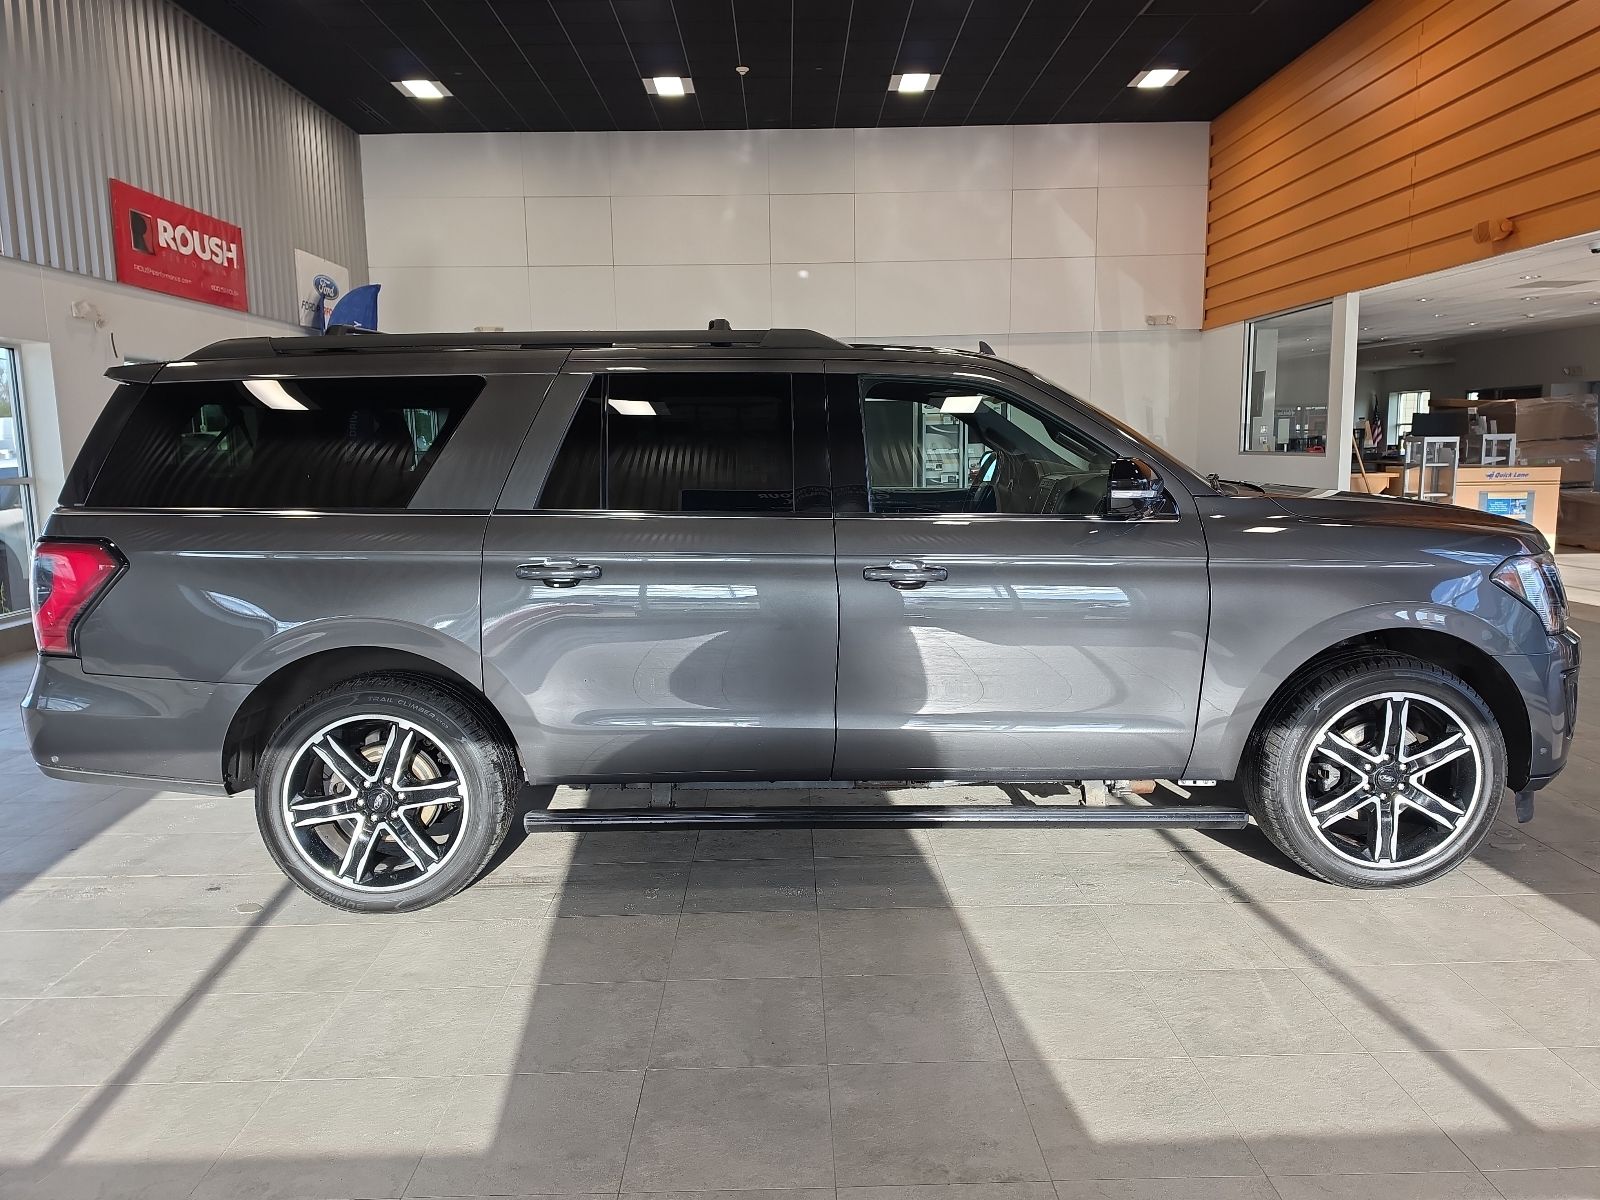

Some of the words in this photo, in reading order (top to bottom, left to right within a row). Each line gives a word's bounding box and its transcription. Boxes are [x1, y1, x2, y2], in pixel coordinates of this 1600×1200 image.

[156, 217, 238, 269] ROUSH
[301, 300, 316, 312] FORD
[367, 695, 393, 703] TRAIL
[397, 699, 436, 719] CLIMBER
[313, 887, 365, 910] SUMMIT
